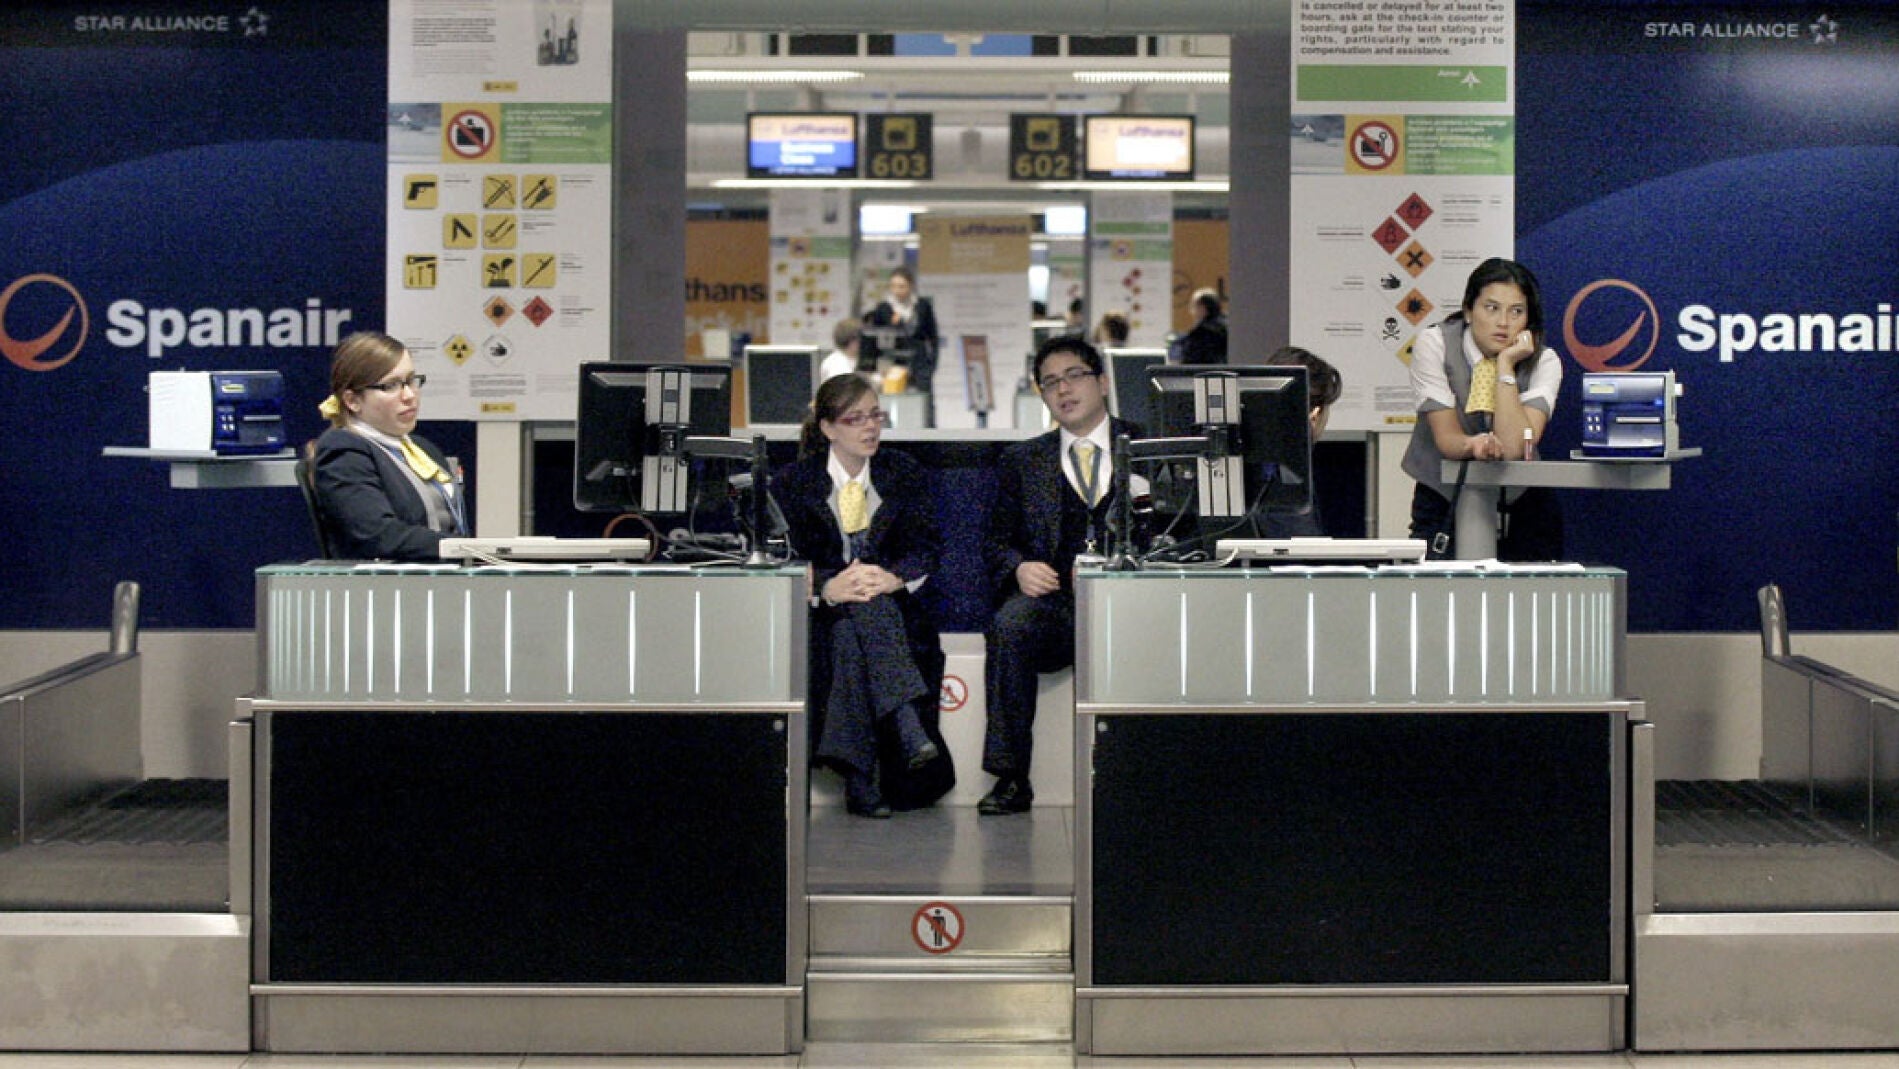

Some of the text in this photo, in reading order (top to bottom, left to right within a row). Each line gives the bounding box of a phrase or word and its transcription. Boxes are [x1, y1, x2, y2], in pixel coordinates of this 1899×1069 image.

[1313, 1, 1364, 10] cancelled
[1381, 2, 1422, 13] delayed
[1425, 1, 1440, 11] for
[1444, 3, 1454, 11] at
[1457, 3, 1483, 11] least
[74, 15, 229, 32] STAR ALLIANCE
[1339, 13, 1357, 21] ask
[1377, 13, 1394, 21] the
[1398, 13, 1444, 22] check-in
[1448, 14, 1489, 22] counter
[1301, 24, 1504, 35] boarding gate for the text stating your
[1644, 22, 1799, 38] STAR ALLIANCE
[1301, 35, 1337, 45] rights,
[1345, 35, 1410, 45] particularly
[1418, 36, 1442, 44] with
[1448, 36, 1486, 47] regard
[1301, 47, 1373, 56] compensation
[1375, 47, 1394, 55] and
[781, 123, 848, 136] Lufthansa
[1118, 126, 1185, 138] Lufthansa
[872, 152, 927, 177] 603
[1014, 153, 1070, 177] 602
[105, 297, 352, 358] Spanair
[1676, 302, 1899, 363] Spanai
